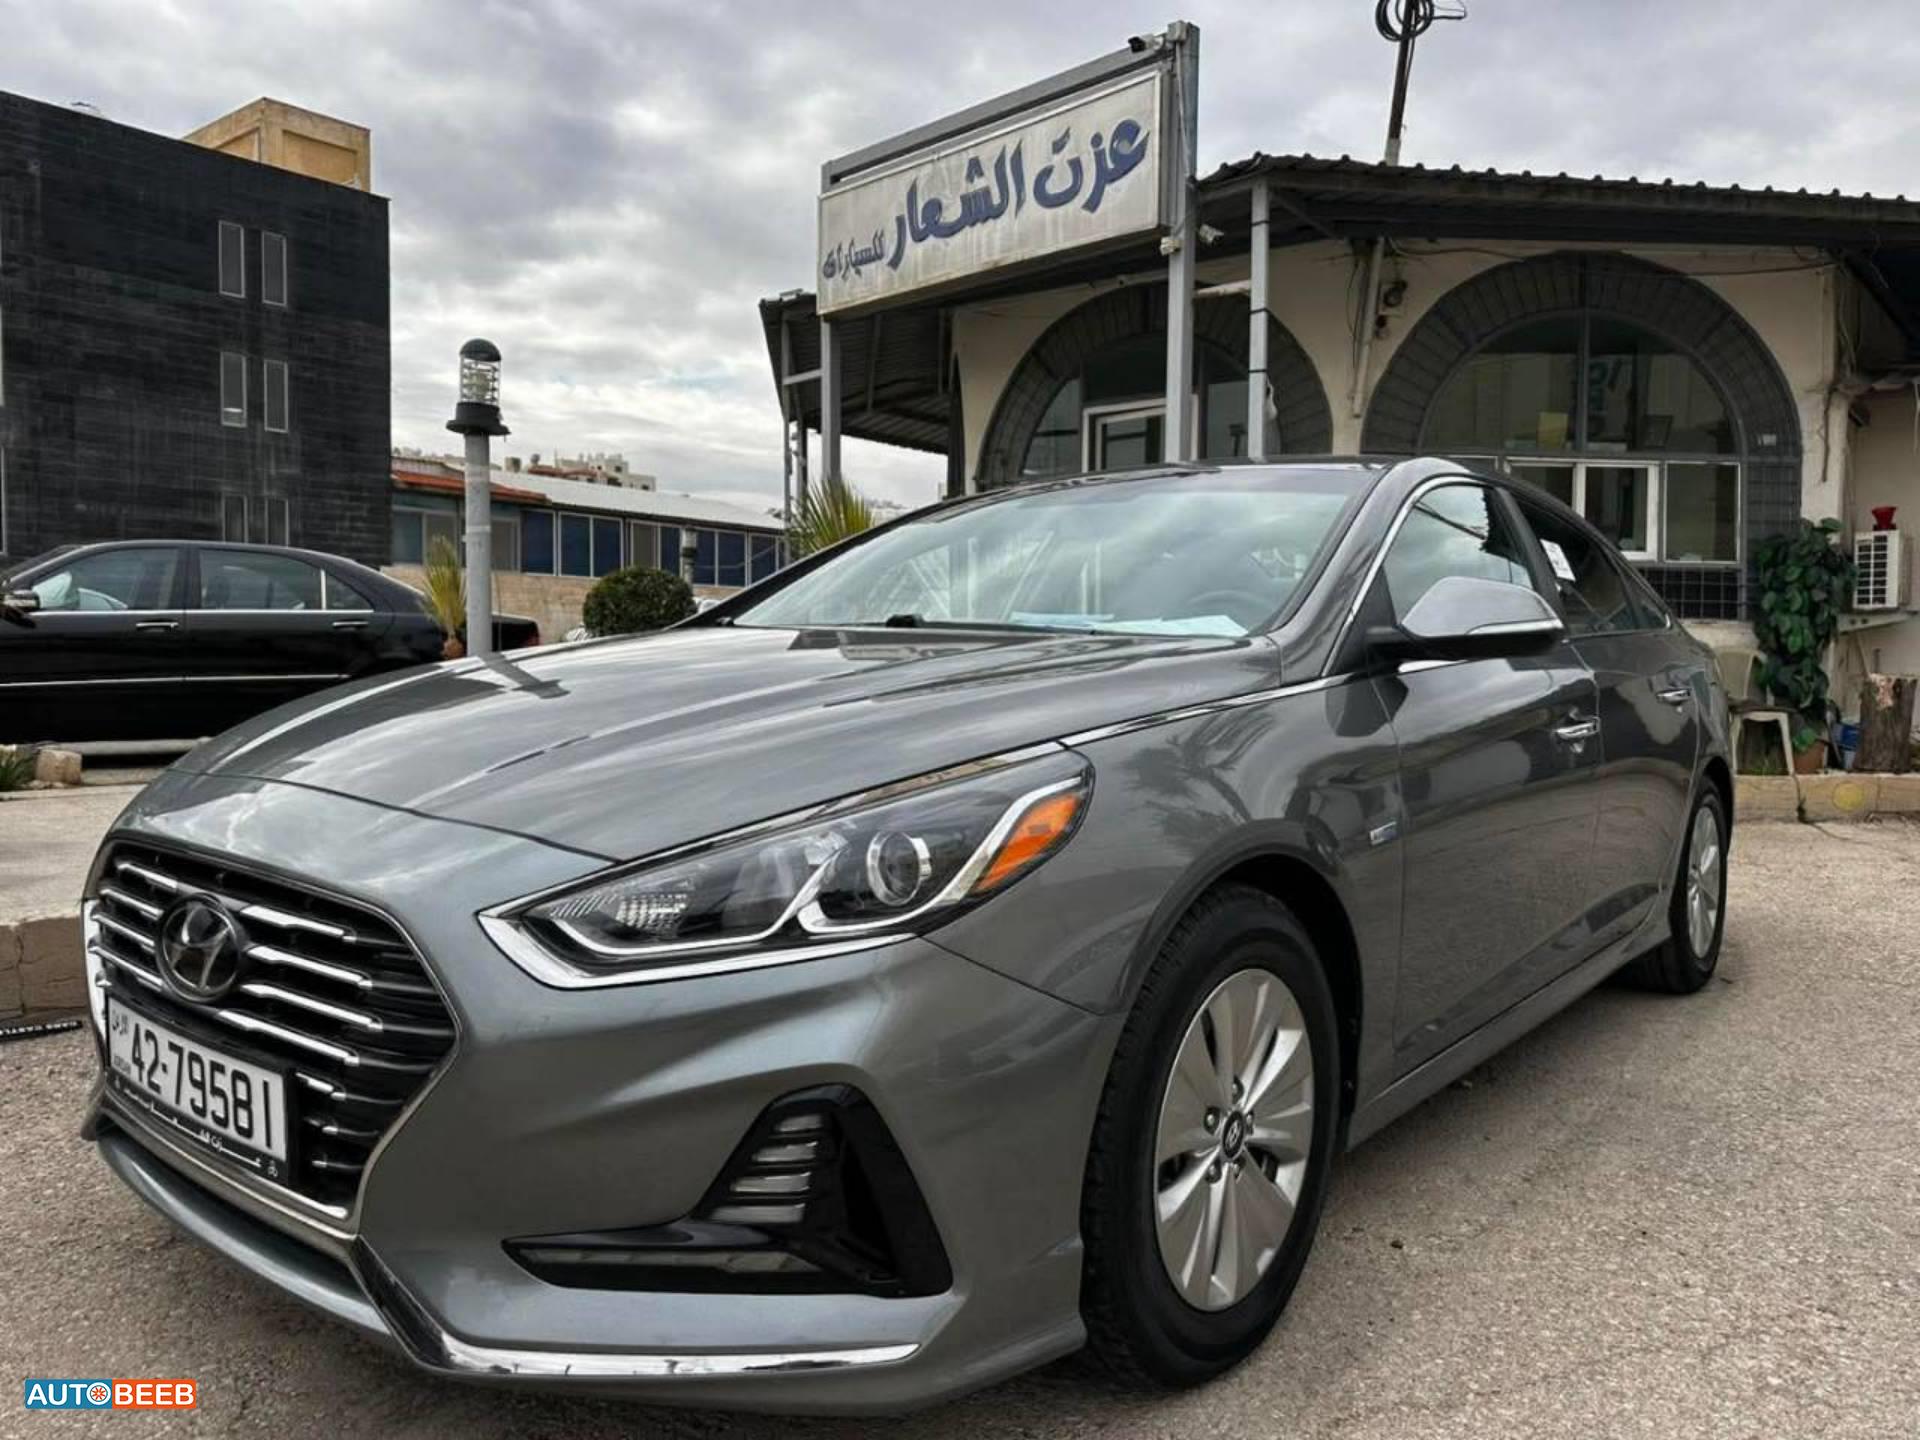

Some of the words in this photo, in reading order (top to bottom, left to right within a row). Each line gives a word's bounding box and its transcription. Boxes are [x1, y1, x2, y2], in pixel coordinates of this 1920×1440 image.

[887, 138, 1026, 270] الشعار
[1033, 119, 1150, 214] عزت
[823, 229, 885, 280] للسيارات
[132, 1023, 272, 1149] 42-79581
